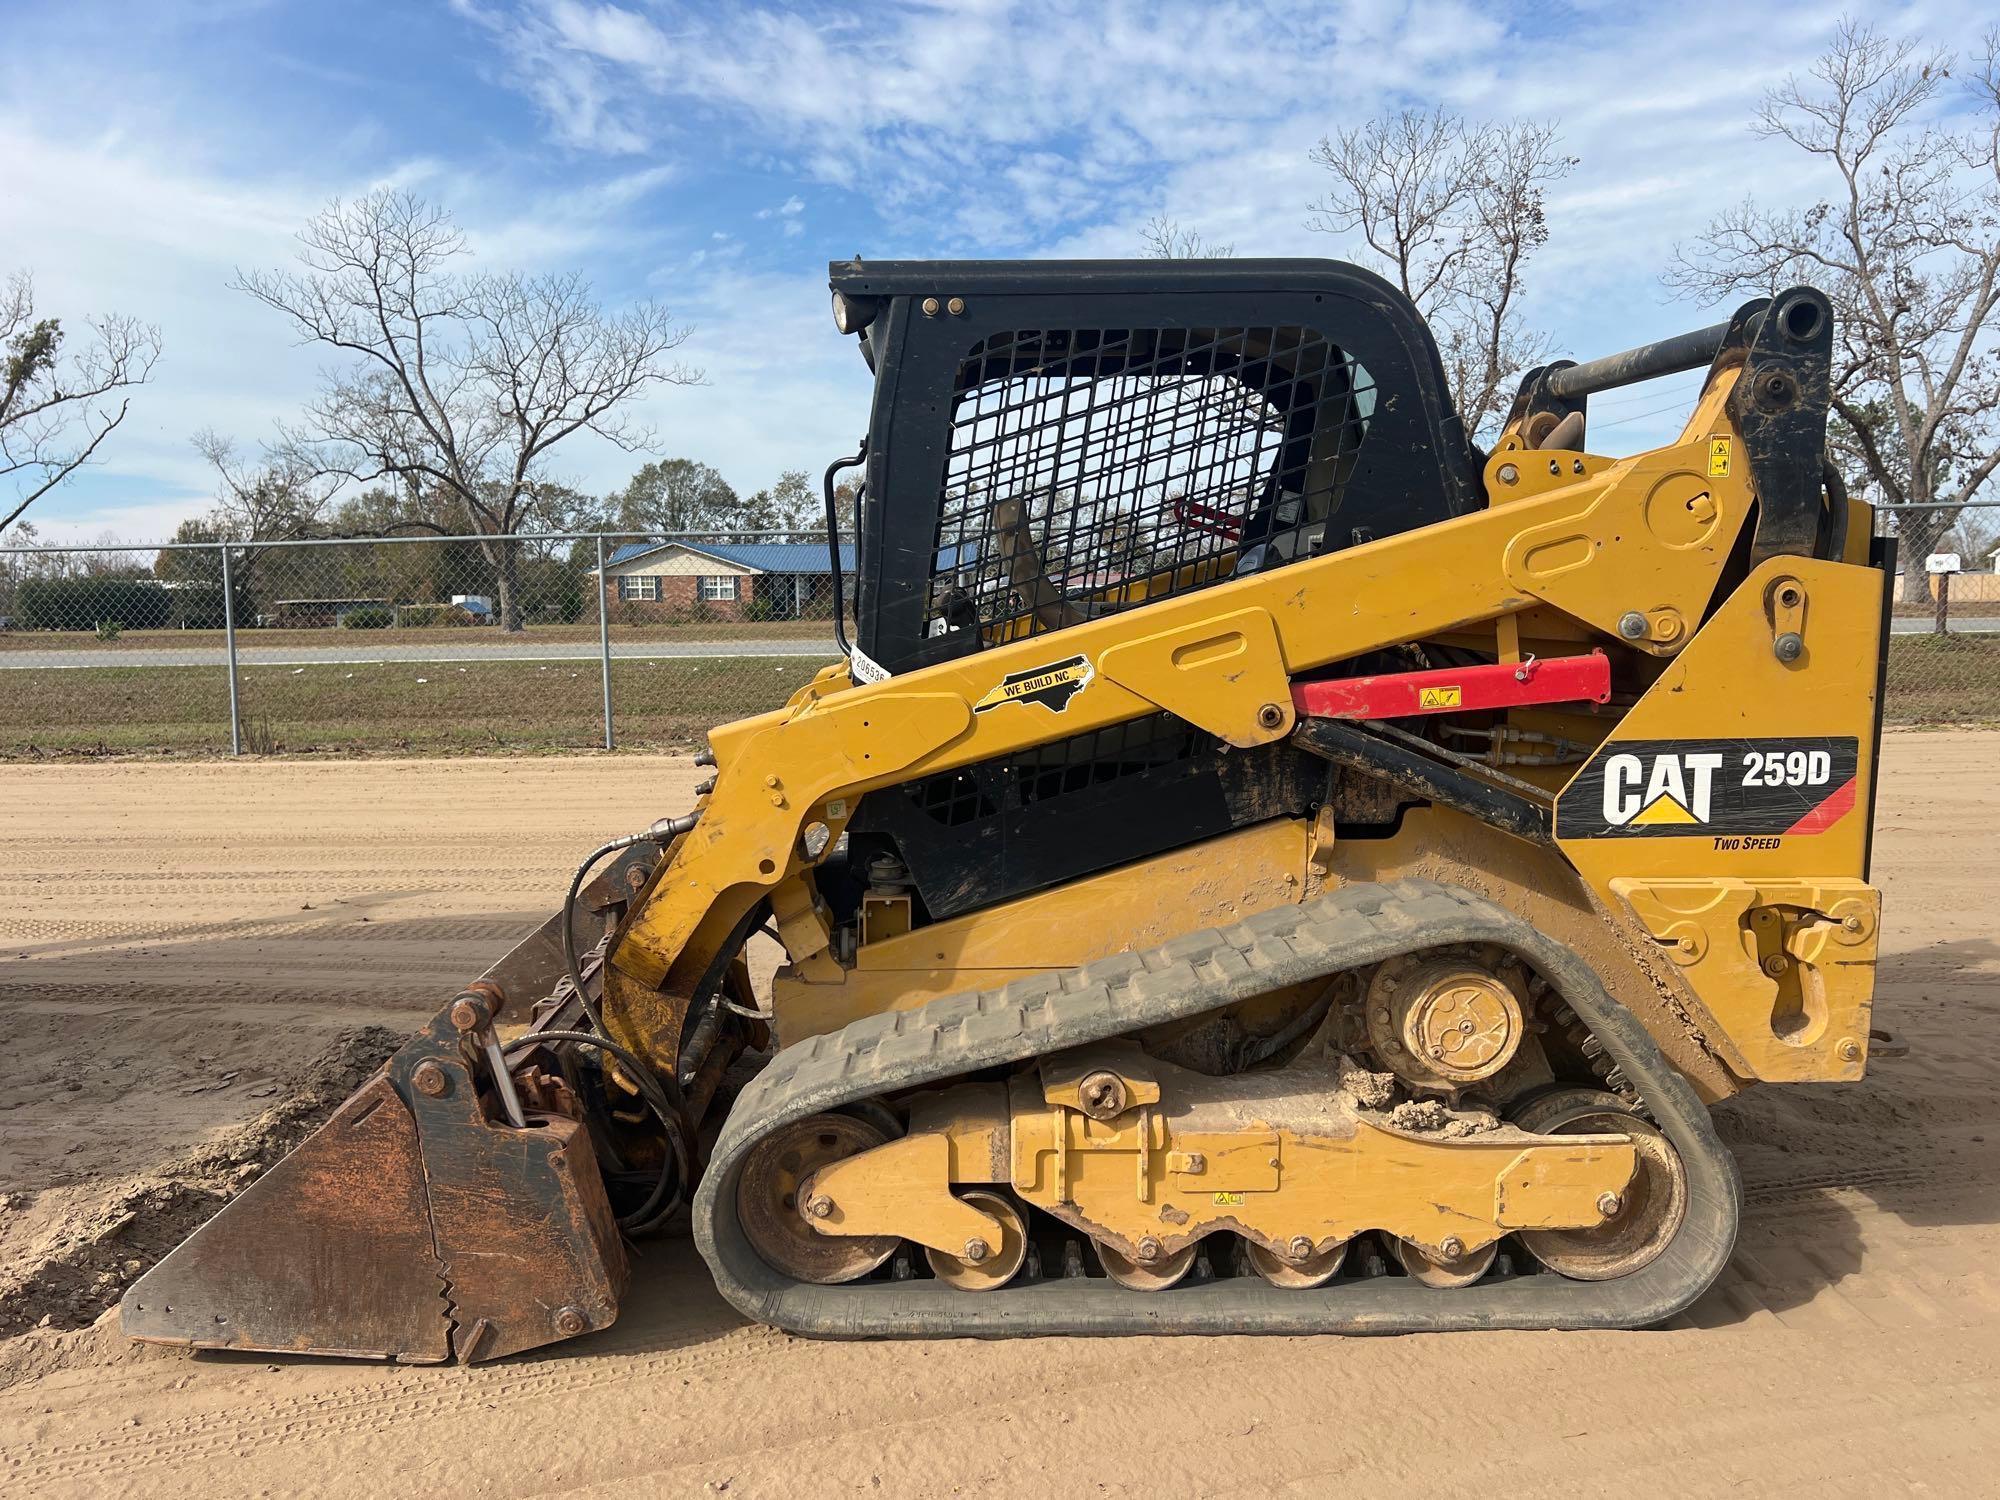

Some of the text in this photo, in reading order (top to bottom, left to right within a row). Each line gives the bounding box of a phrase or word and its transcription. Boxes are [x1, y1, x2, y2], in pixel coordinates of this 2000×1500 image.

[1004, 670, 1069, 697] WE BUILD NC
[1602, 750, 1831, 826] CAT 259D
